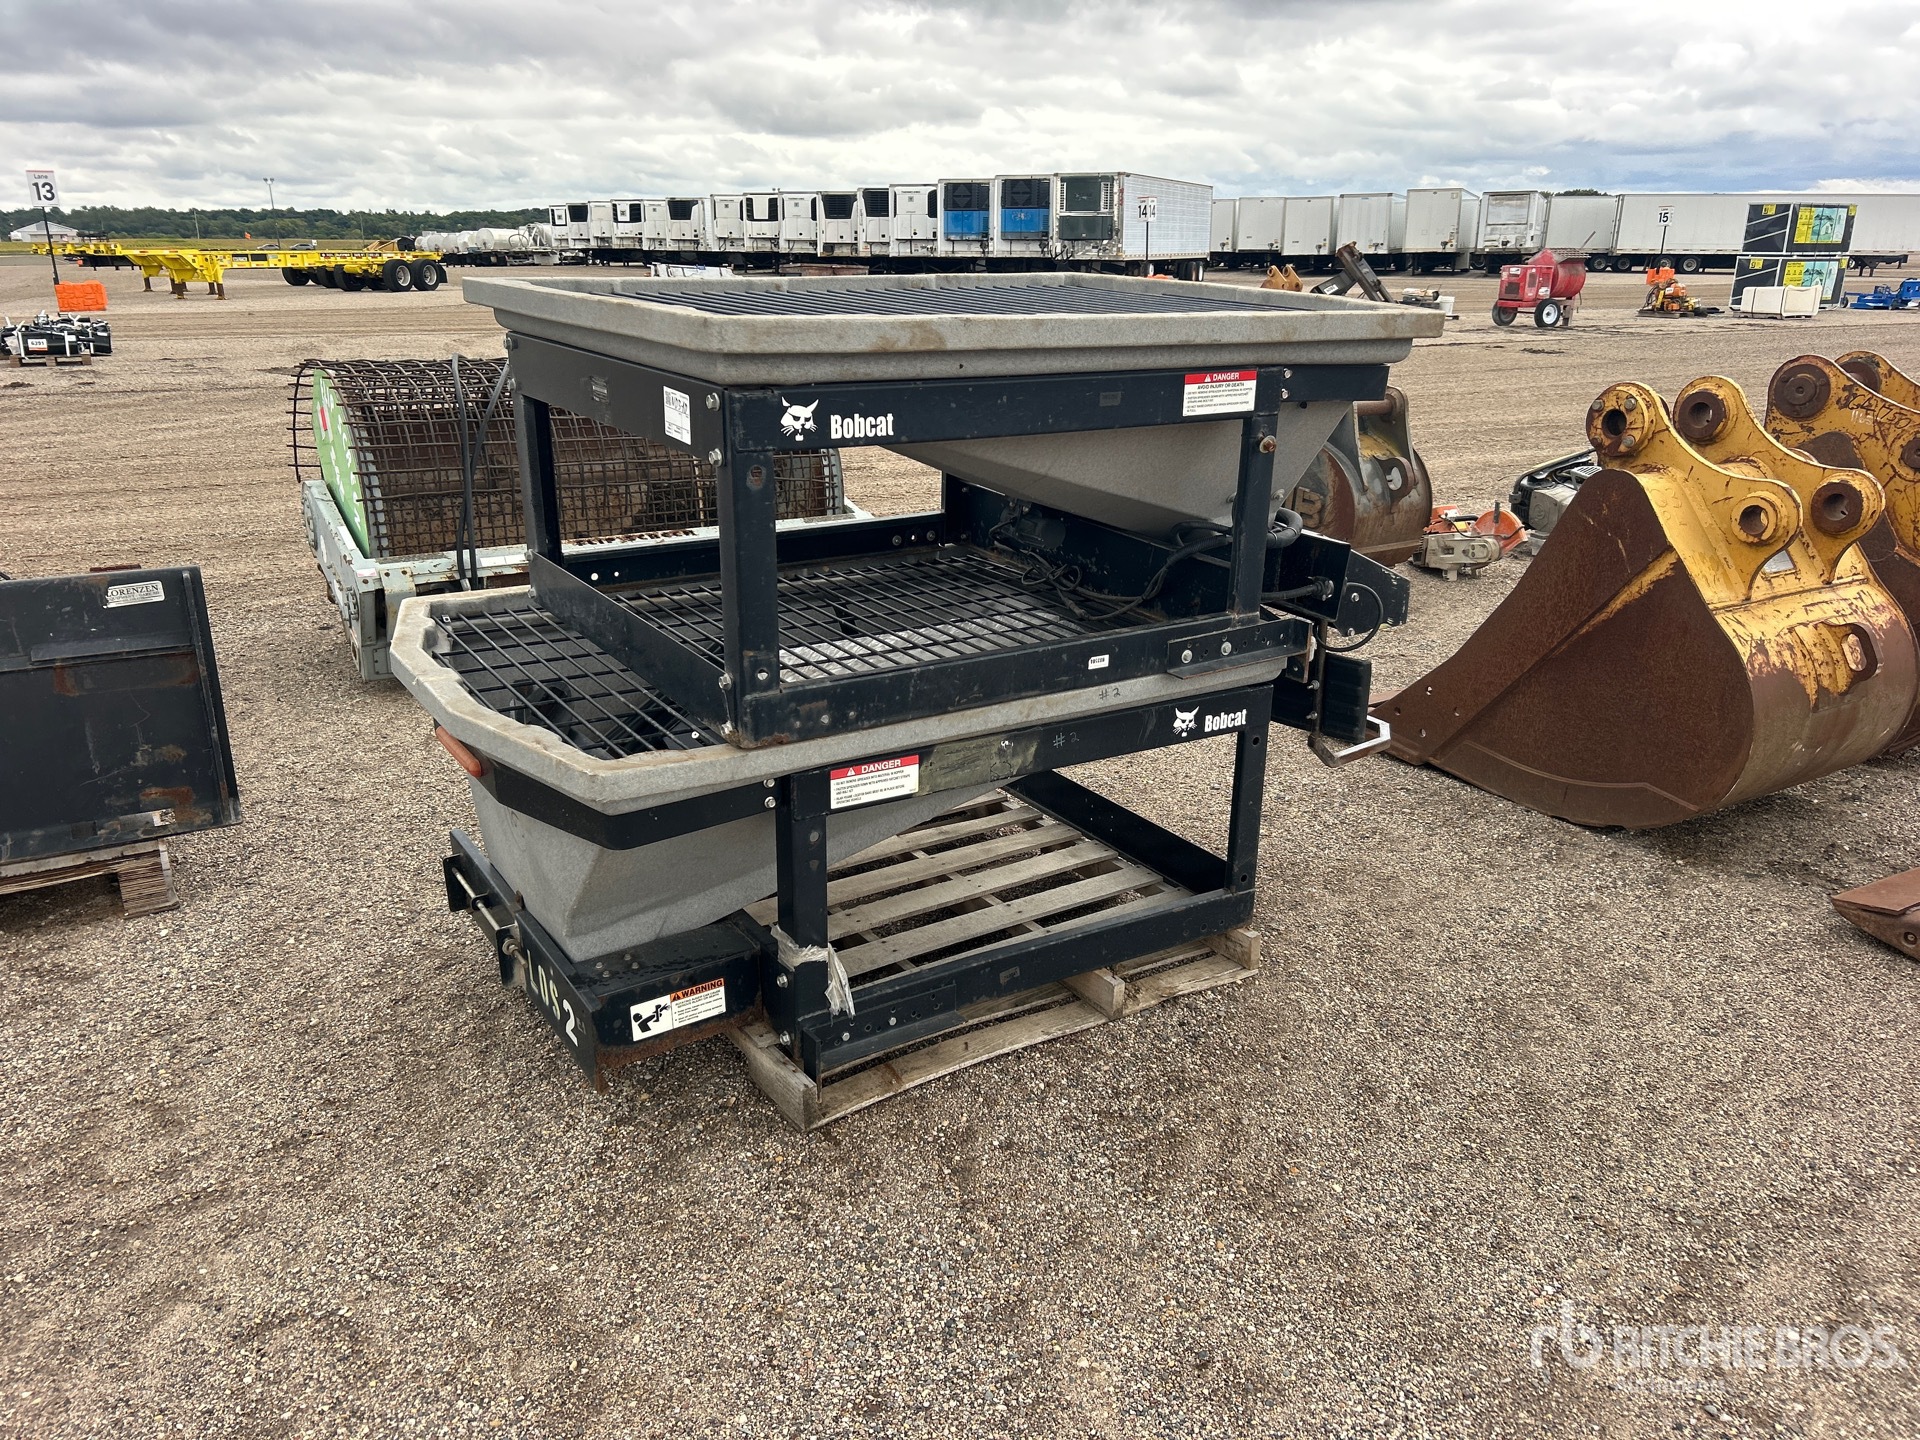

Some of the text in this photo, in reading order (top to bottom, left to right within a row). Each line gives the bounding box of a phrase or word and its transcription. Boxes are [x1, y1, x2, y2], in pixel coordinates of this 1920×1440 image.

[32, 182, 55, 201] 13
[1138, 205, 1147, 218] 14
[1659, 212, 1669, 223] 15
[1213, 372, 1240, 381] DANGER
[830, 413, 894, 439] Bobcat
[1204, 708, 1247, 733] Bobcat
[861, 759, 901, 774] DANGER
[681, 979, 723, 997] WARNING
